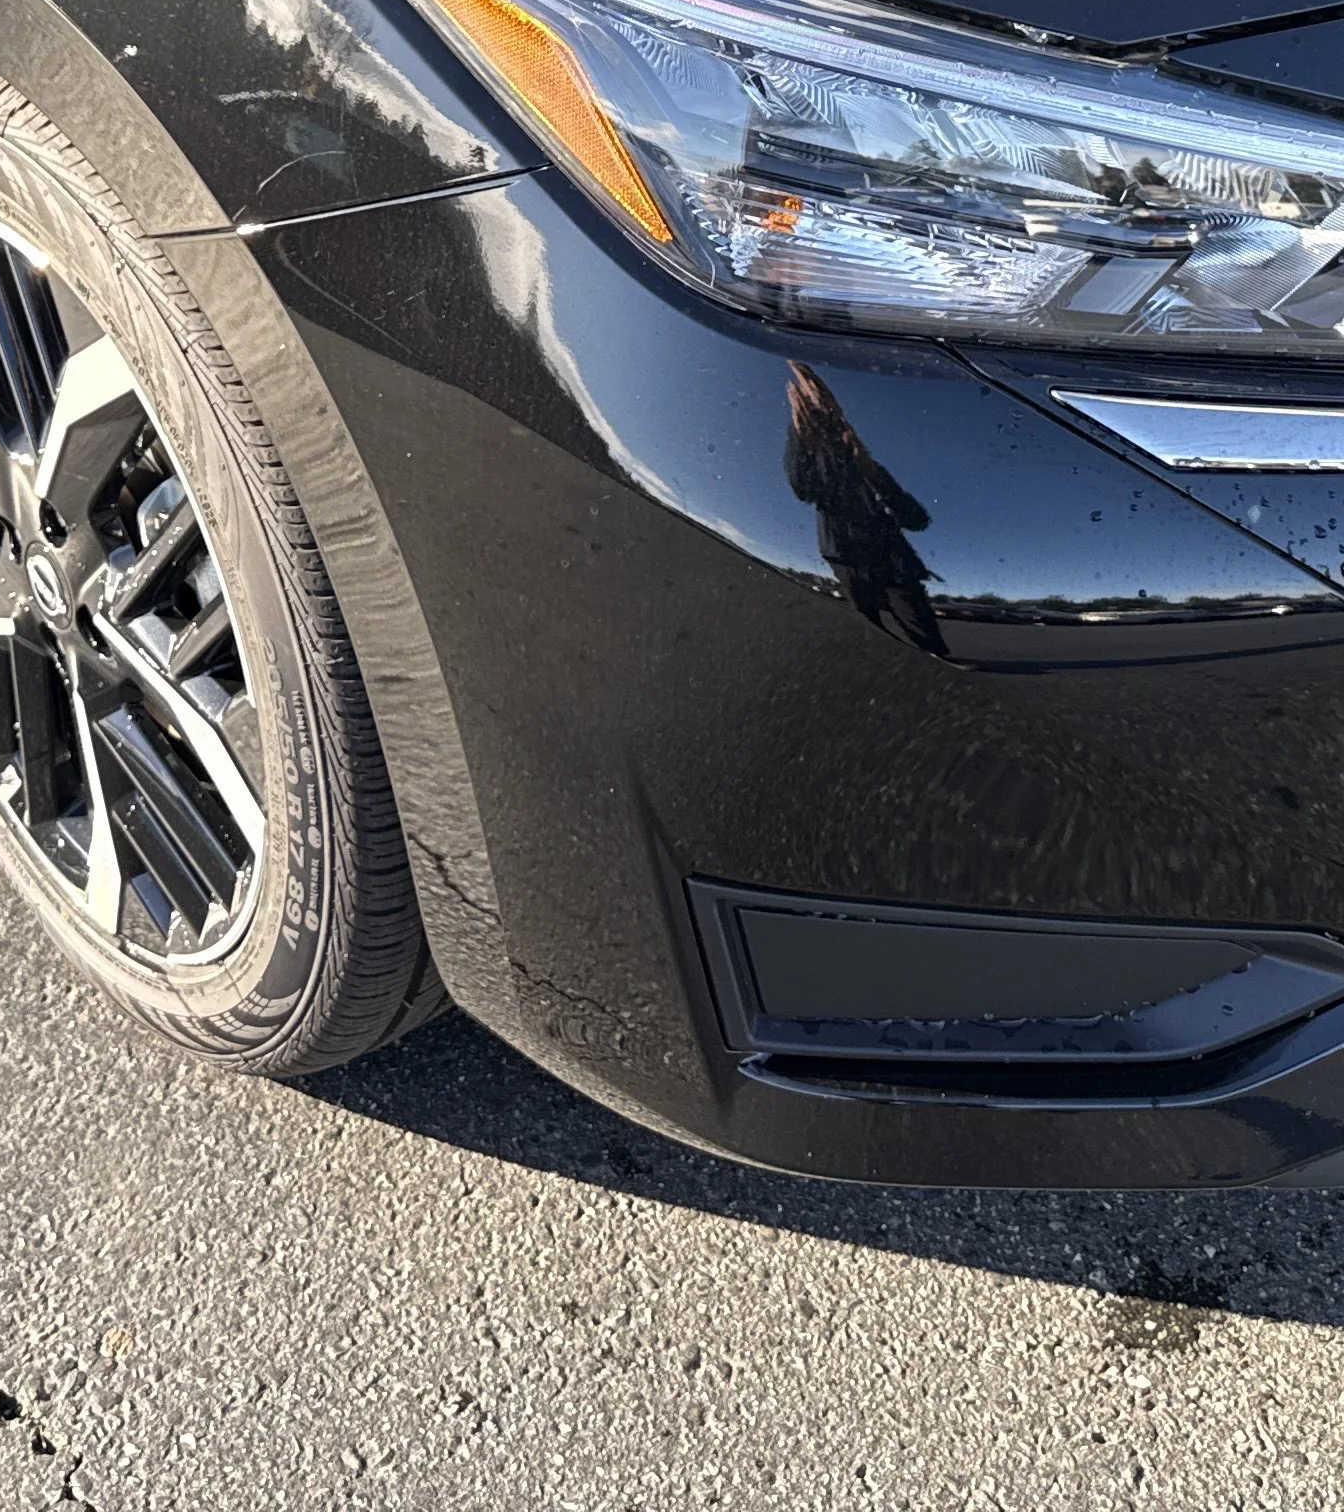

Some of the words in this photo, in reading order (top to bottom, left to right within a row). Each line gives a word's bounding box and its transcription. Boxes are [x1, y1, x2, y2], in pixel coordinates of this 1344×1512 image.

[260, 638, 300, 786] 205/50
[286, 791, 303, 821] R
[288, 828, 305, 869] 17
